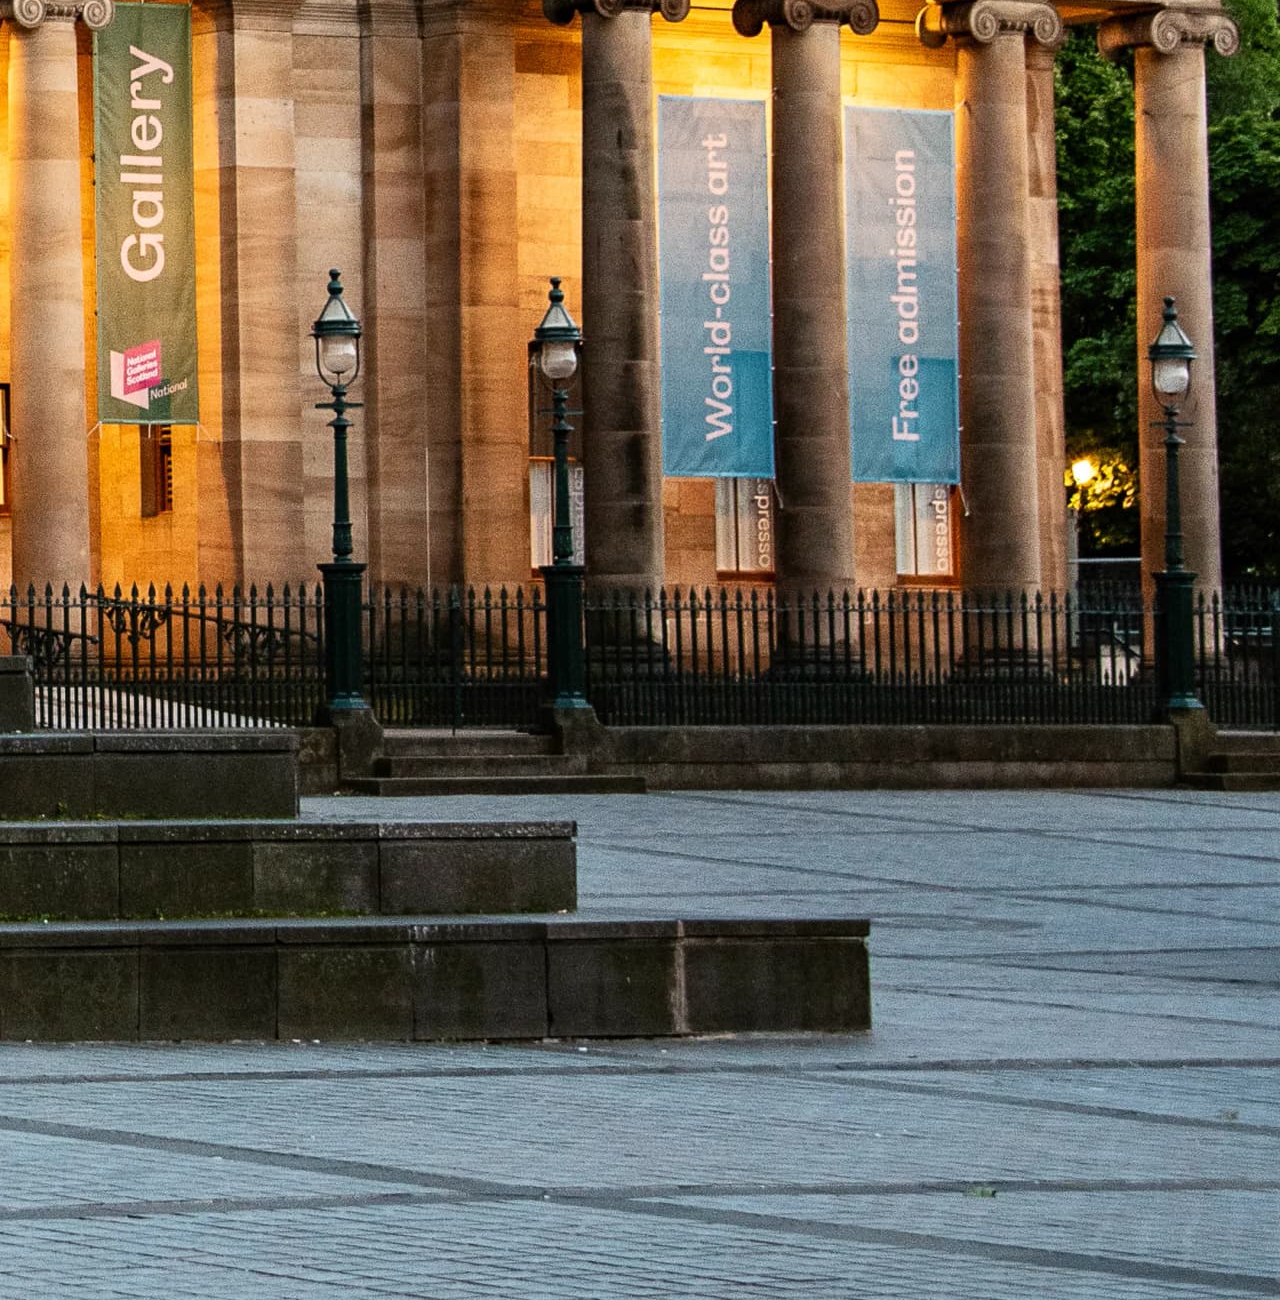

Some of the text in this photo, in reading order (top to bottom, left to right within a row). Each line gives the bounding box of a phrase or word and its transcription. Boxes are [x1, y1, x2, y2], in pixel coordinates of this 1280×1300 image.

[120, 45, 175, 283] Gallery
[702, 132, 734, 442] World-class art
[889, 148, 921, 443] Free admission
[126, 360, 158, 377] Galleries
[126, 368, 158, 386] Scotland
[127, 348, 157, 367] National
[149, 377, 188, 400] National
[754, 478, 771, 568] spresso
[931, 484, 949, 572] spresso
